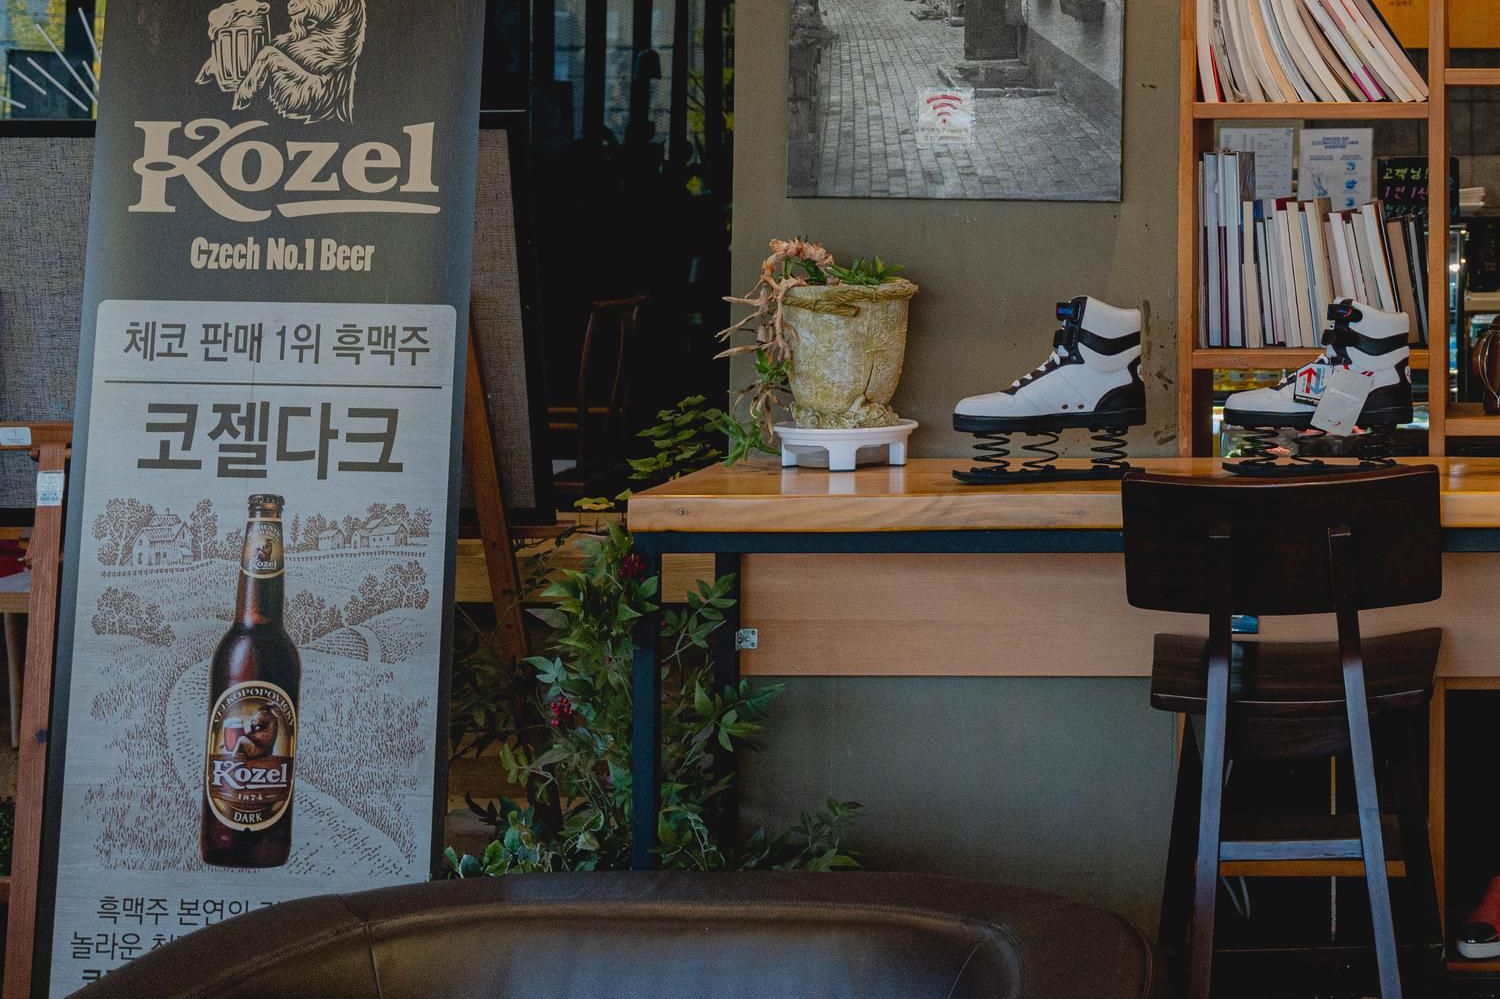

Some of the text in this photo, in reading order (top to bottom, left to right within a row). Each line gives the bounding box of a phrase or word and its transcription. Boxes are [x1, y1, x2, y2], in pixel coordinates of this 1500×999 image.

[128, 118, 440, 222] Kozel
[190, 236, 375, 271] Czech No.1 Beer
[123, 321, 430, 366] 체코 판매 1위 흑맥주
[137, 400, 403, 480] 코젤다크
[212, 760, 288, 790] Kozel
[234, 812, 263, 823] DARK
[97, 896, 169, 925] 흑맥주
[70, 931, 143, 960] 놀라운
